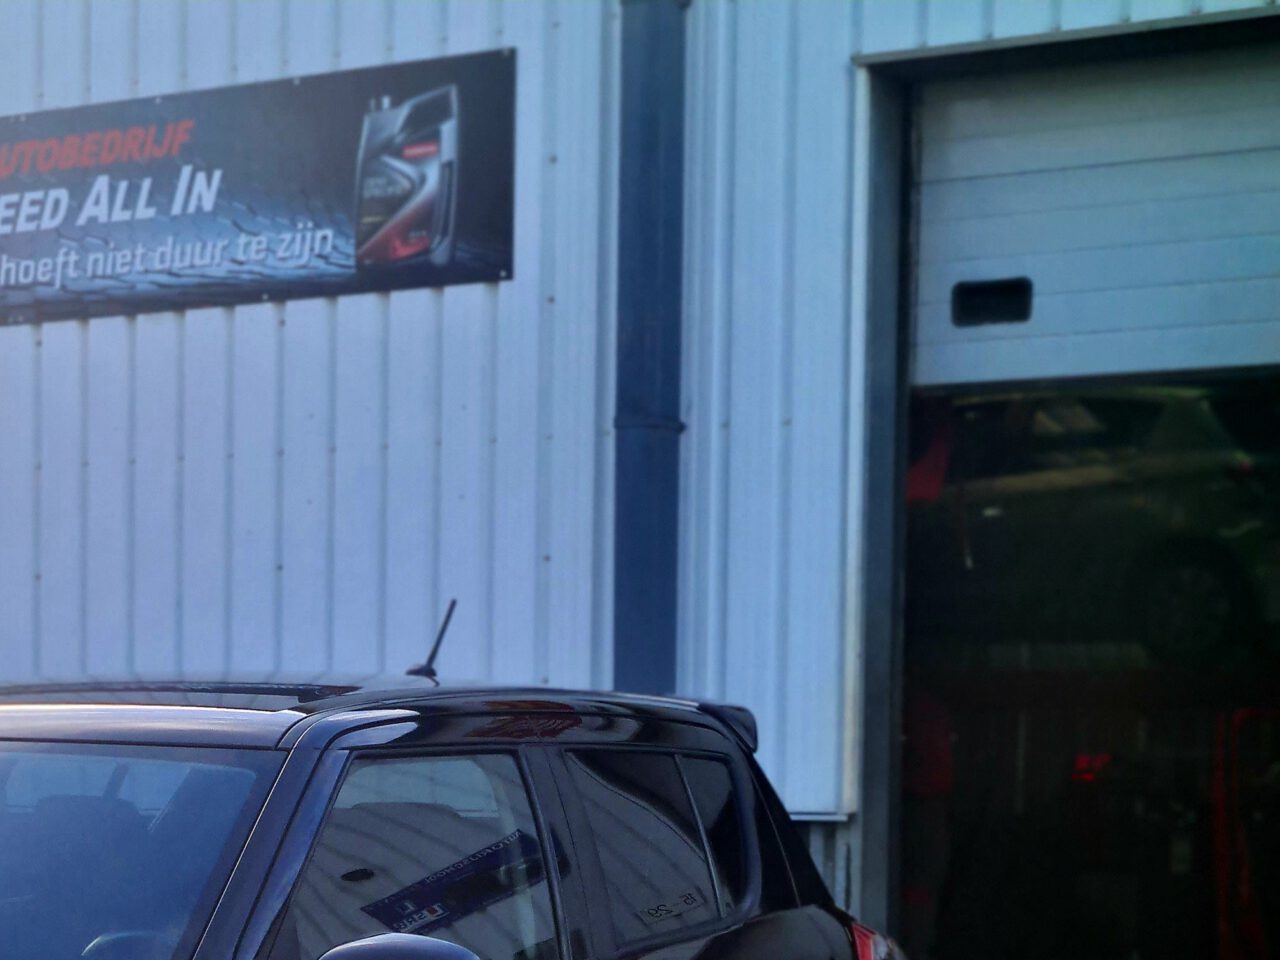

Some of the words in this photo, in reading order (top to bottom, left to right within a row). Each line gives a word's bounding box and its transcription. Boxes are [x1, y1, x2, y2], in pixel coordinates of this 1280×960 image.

[75, 174, 157, 226] ALL
[171, 164, 223, 216] IN
[0, 248, 80, 290] hoeft
[87, 242, 147, 278] niet
[153, 236, 228, 270] duur
[238, 229, 268, 261] te
[275, 221, 334, 268] zijn
